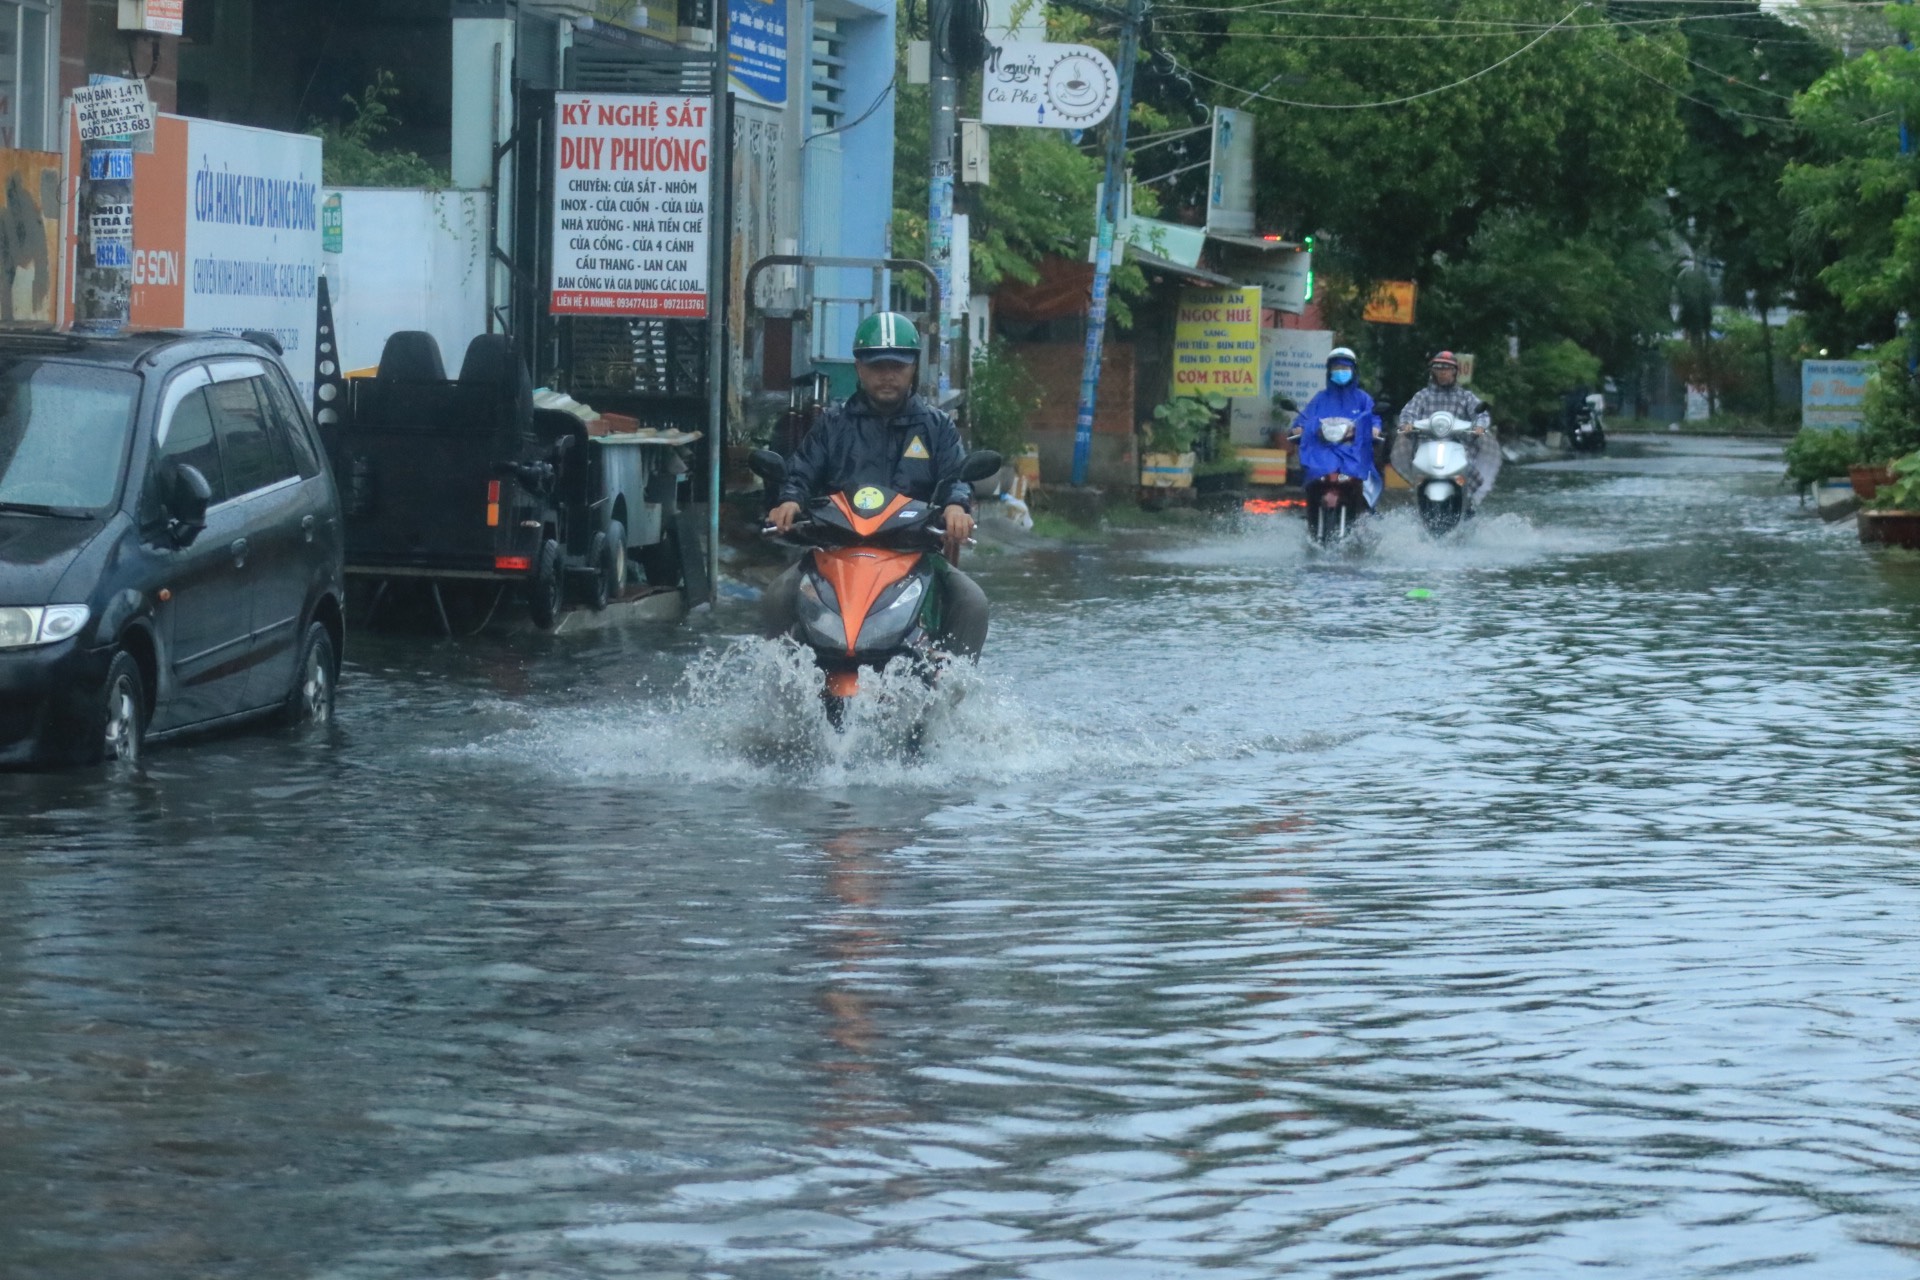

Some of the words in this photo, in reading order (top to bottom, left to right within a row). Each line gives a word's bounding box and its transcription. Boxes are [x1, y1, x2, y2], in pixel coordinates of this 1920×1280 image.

[119, 85, 132, 97] 1.4
[1011, 88, 1038, 103] Phê
[562, 99, 592, 125] KỸ
[598, 101, 659, 131] NGHỆ
[665, 98, 707, 127] SẮT
[81, 118, 151, 139] 0901.133.683
[560, 136, 605, 170] DUY
[610, 136, 707, 172] PHƯƠNG
[216, 161, 242, 225] HÀNG
[568, 178, 611, 192] CHUYÊN:
[614, 177, 635, 193] CỬA
[637, 177, 656, 193] SẮT
[665, 179, 697, 194] NHÔM
[560, 199, 587, 211] INOX
[596, 196, 617, 212] CỬA
[619, 196, 650, 213] CUỐN
[661, 197, 682, 213] CỬA
[561, 216, 584, 231] NHÀ
[586, 216, 624, 231] XƯỞNG
[633, 217, 655, 232] NHÀ
[683, 218, 703, 233] CHẾ
[569, 234, 590, 250] CỬA
[632, 236, 653, 251] CỬA
[656, 240, 663, 252] 4
[665, 237, 694, 252] CÁNH
[600, 258, 635, 271] THANG
[644, 259, 663, 271] LAN
[666, 260, 687, 272] CAN
[558, 277, 575, 289] BAN
[577, 275, 602, 289] CÔNG
[604, 275, 615, 289] VÀ
[617, 278, 633, 290] GIA
[634, 278, 658, 293] DỤNG
[660, 276, 677, 291] CÁC
[556, 294, 571, 307] LIÊN
[573, 294, 582, 309] HỆ
[584, 297, 589, 307] A
